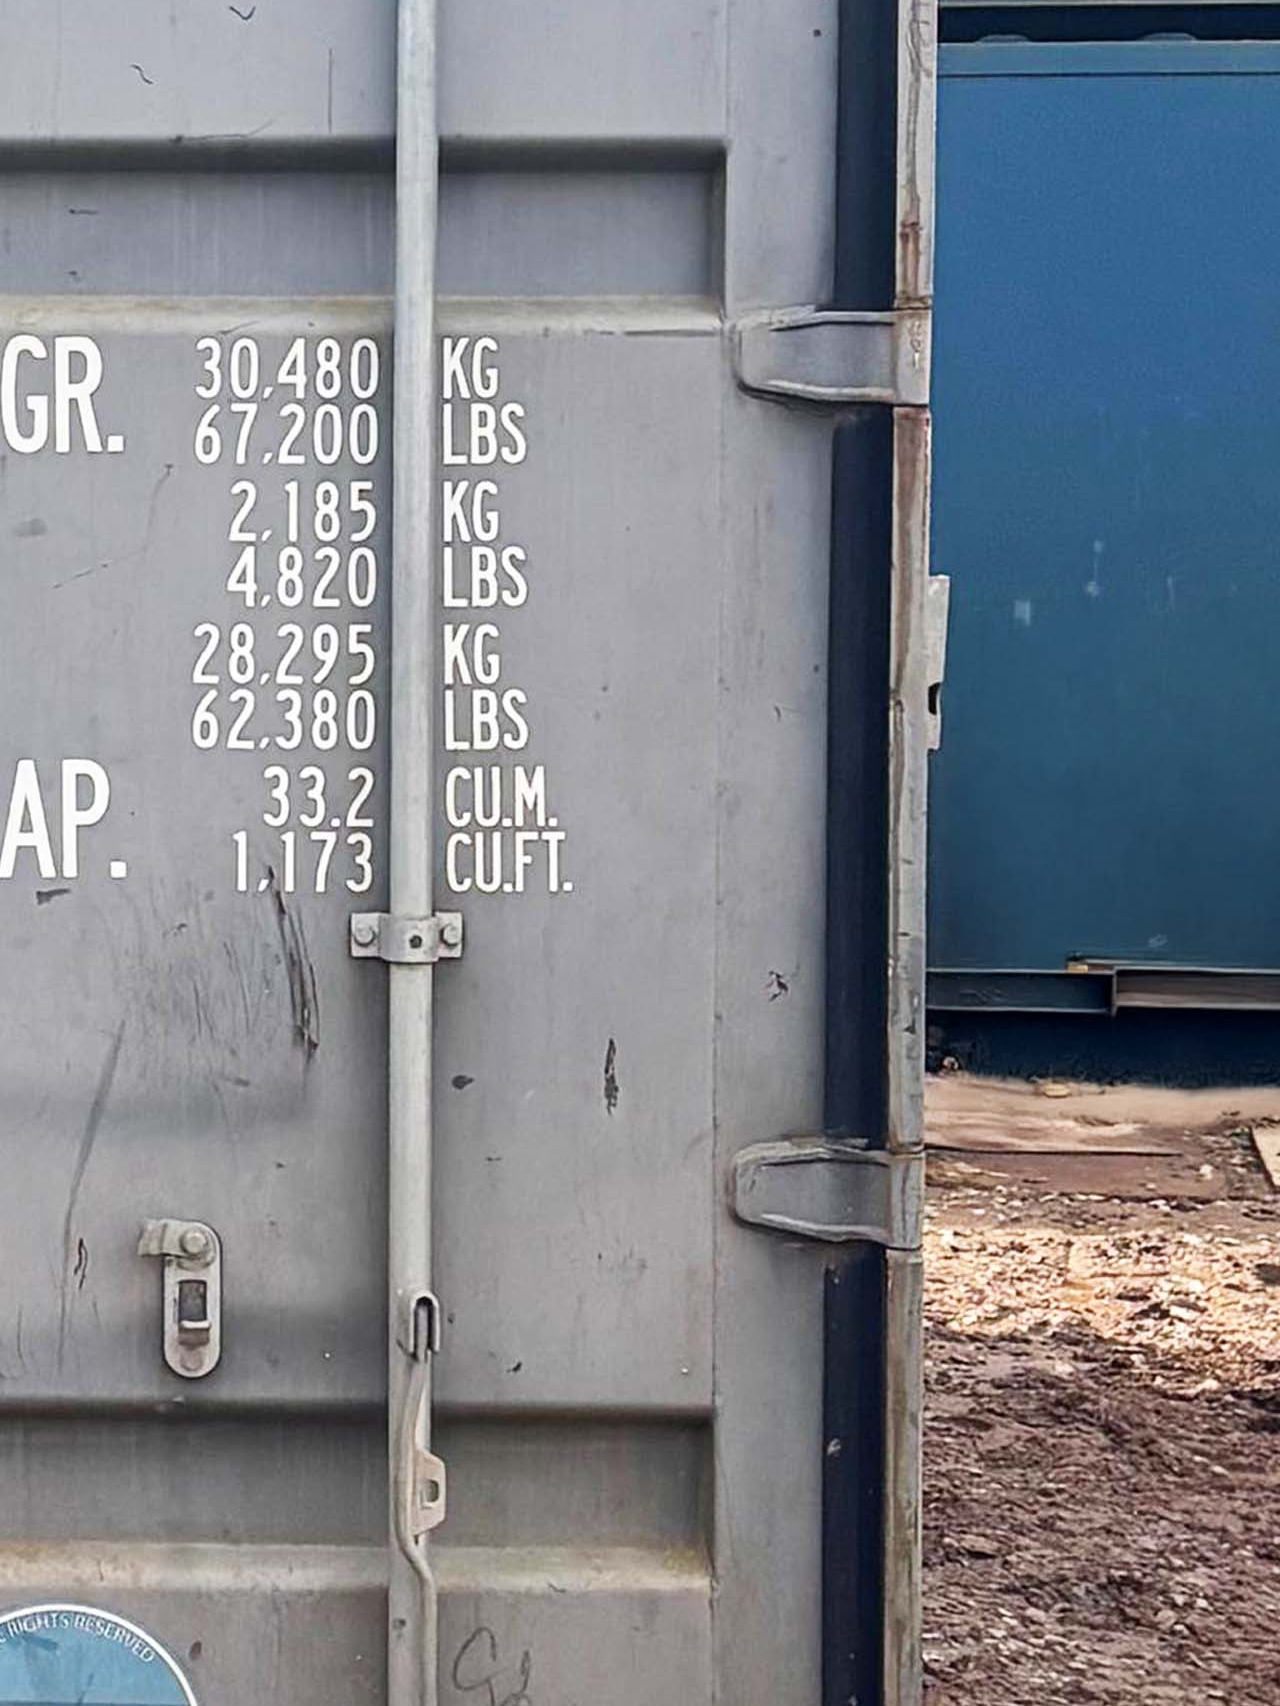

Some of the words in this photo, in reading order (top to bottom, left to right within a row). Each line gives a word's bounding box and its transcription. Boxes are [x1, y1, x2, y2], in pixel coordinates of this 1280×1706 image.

[194, 336, 379, 401] 30,480
[443, 337, 499, 400] KG
[193, 403, 379, 467] 67,200
[443, 403, 528, 466] LBS
[228, 480, 377, 545] 2,185
[443, 480, 499, 544] KG
[225, 546, 378, 610] 4,820
[443, 546, 529, 609] LBS
[191, 623, 376, 688] 28,295
[443, 623, 500, 686] KG
[191, 689, 377, 753] 62,380
[443, 689, 529, 752] LBS
[262, 766, 375, 829] 33.2
[232, 831, 375, 895] 1,173
[7, 1612, 70, 1638] RIGHTS
[73, 1614, 155, 1662] RESERVED
